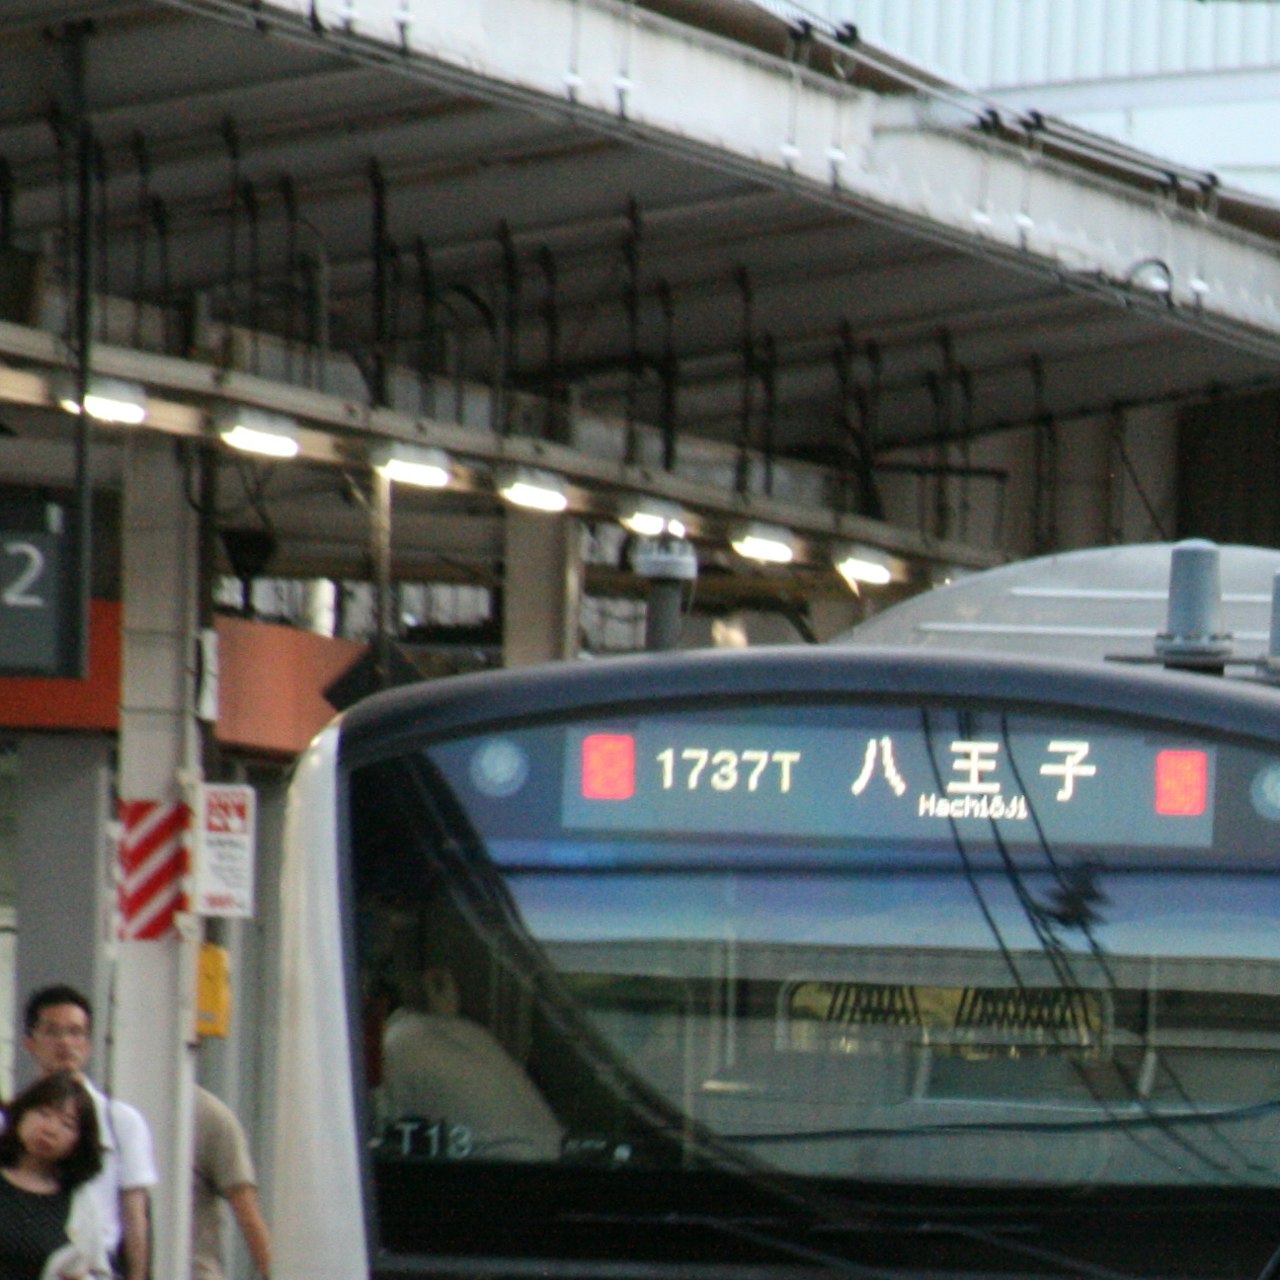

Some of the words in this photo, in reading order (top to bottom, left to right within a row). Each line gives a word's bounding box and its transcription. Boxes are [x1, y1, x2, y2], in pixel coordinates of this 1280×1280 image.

[4, 542, 44, 606] 2
[656, 748, 800, 793] 1737T
[850, 736, 1098, 801] 八王子
[395, 1121, 473, 1159] T13
